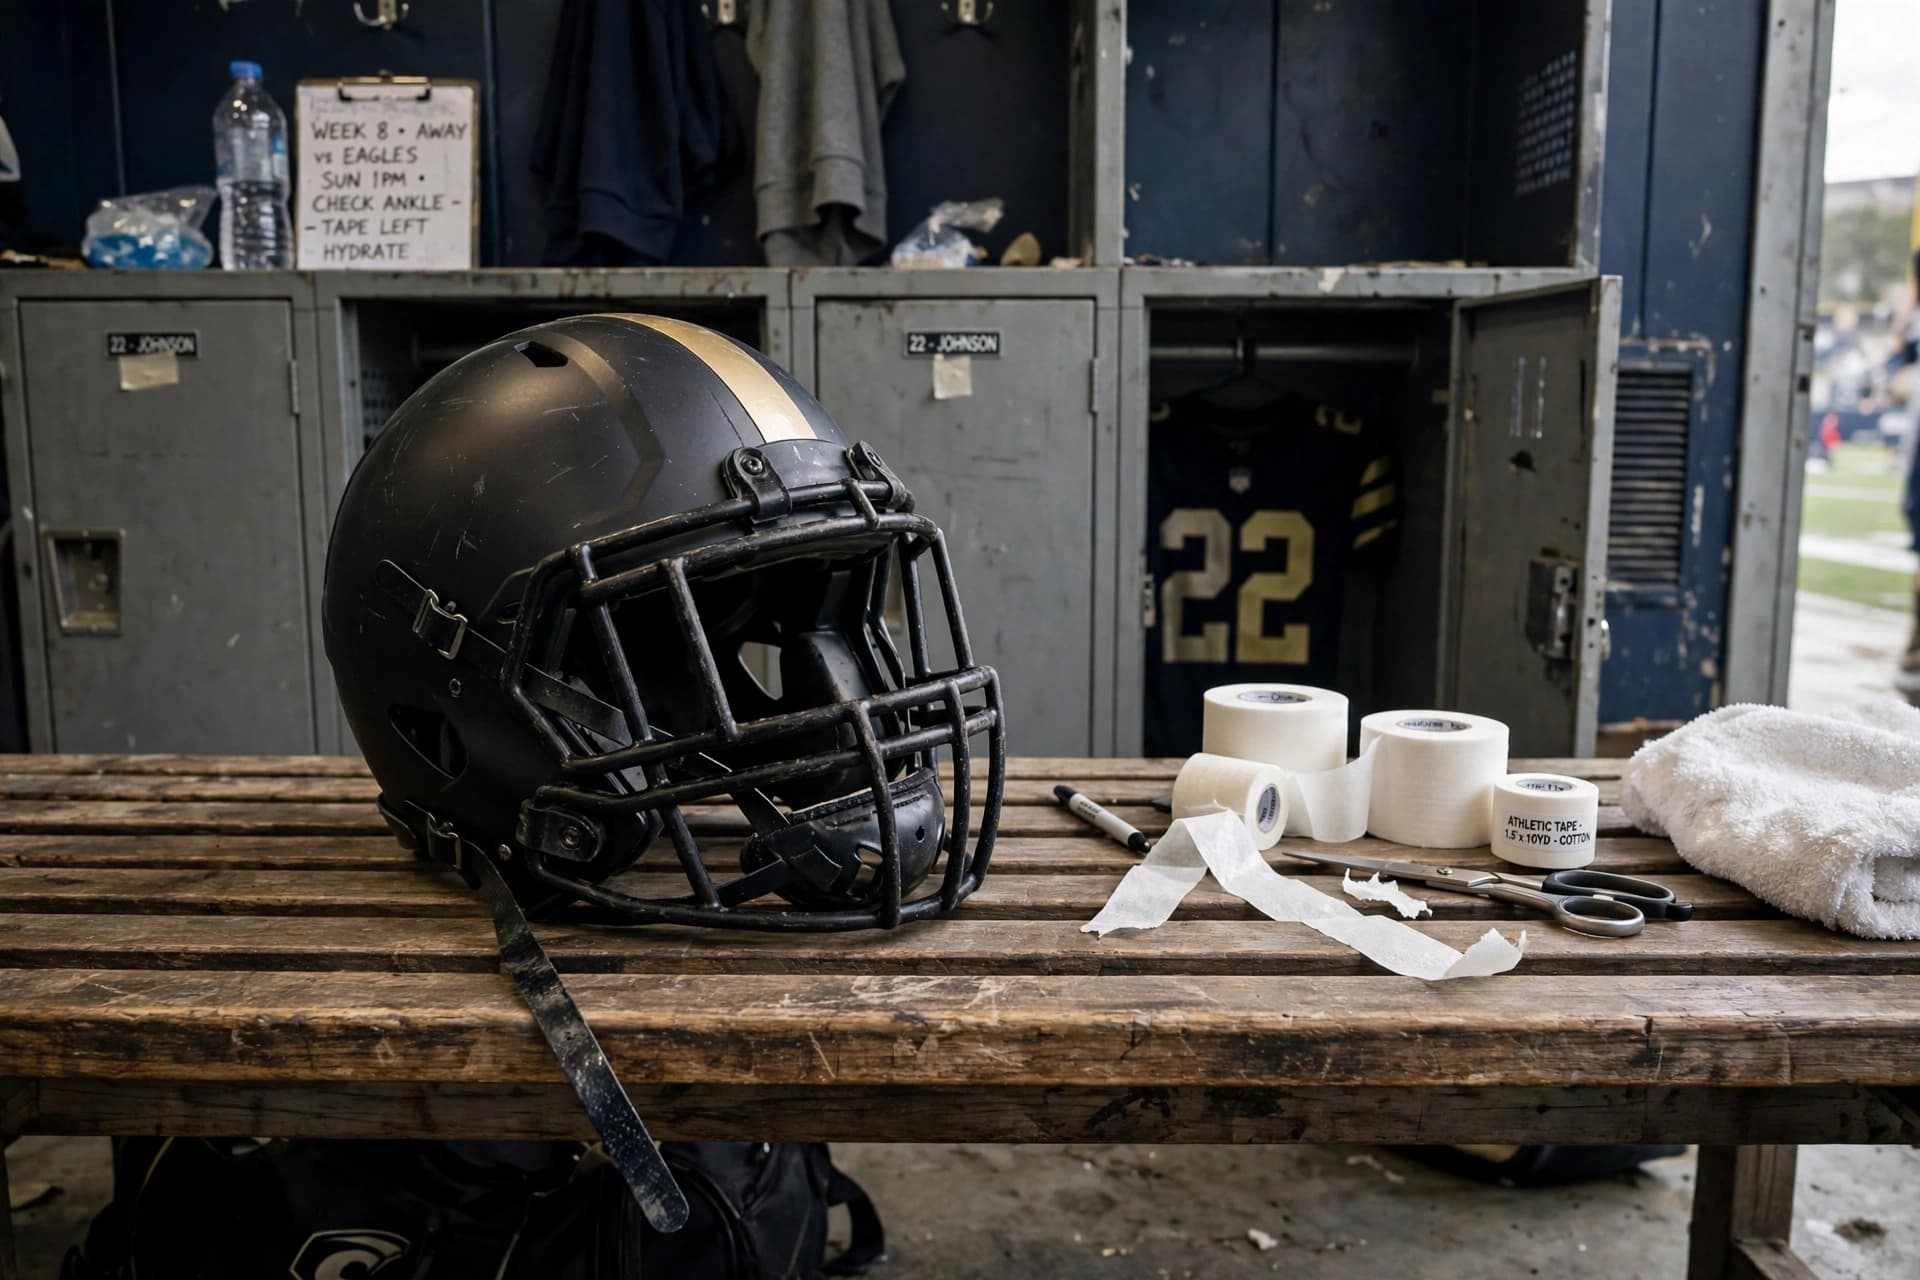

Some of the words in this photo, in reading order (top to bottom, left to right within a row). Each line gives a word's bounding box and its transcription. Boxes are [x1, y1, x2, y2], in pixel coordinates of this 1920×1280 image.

[311, 121, 367, 141] WEEK
[376, 120, 389, 140] 8
[416, 122, 468, 140] AWAY
[343, 146, 418, 165] EAGLES
[321, 170, 361, 190] SUN
[373, 170, 407, 189] 1PM
[312, 194, 374, 213] CHECK
[382, 193, 444, 212] ANKLE
[321, 218, 369, 236] TAPE
[380, 217, 430, 236] LEFT
[323, 242, 410, 262] HYDRATE
[110, 335, 126, 353] 22
[137, 335, 195, 353] JOHNSON
[909, 334, 926, 352] 22
[937, 334, 997, 352] JOHNSON
[1160, 507, 1315, 665] 22
[1507, 815, 1552, 832] ATHLETIC
[1554, 820, 1578, 832] TAPE
[1526, 833, 1550, 845] 10YD
[1559, 832, 1591, 846] COTTON
